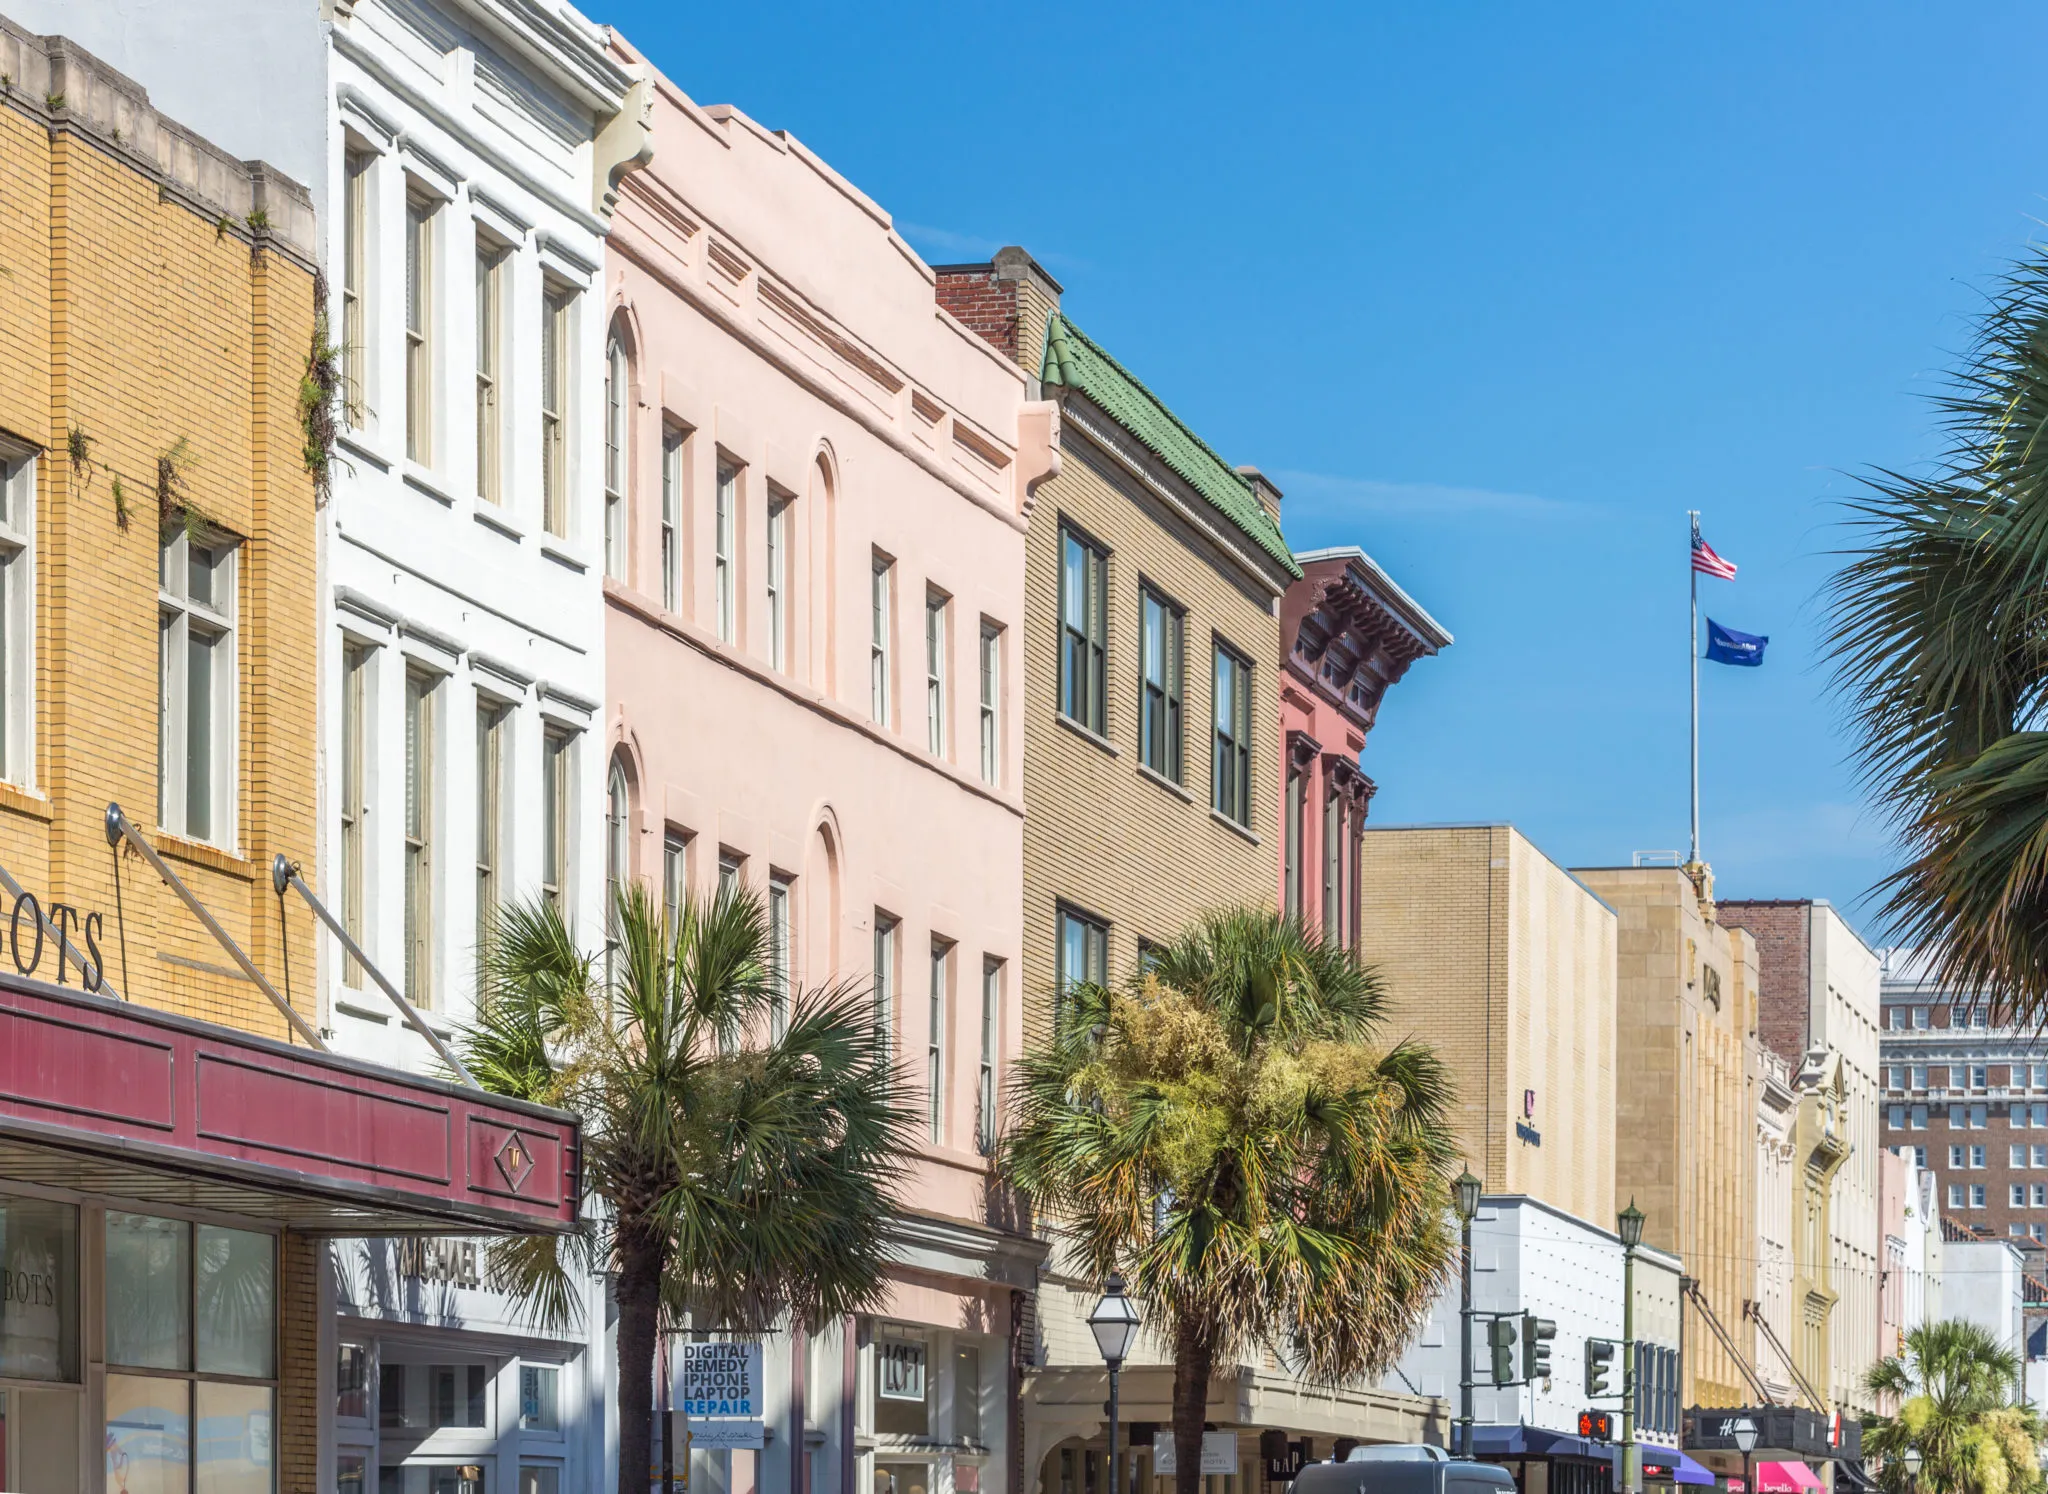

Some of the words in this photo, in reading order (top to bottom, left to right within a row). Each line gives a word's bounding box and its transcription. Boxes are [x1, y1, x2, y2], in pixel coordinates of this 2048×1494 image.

[0, 892, 103, 993] OTS
[684, 1345, 749, 1359] DIGITAL
[684, 1359, 748, 1372] REMEDY
[886, 1343, 922, 1392] LOFT
[684, 1373, 749, 1386] IPHONE
[684, 1387, 750, 1400] LAPTOP
[684, 1400, 751, 1414] REPAIR
[1598, 1418, 1605, 1433] 4
